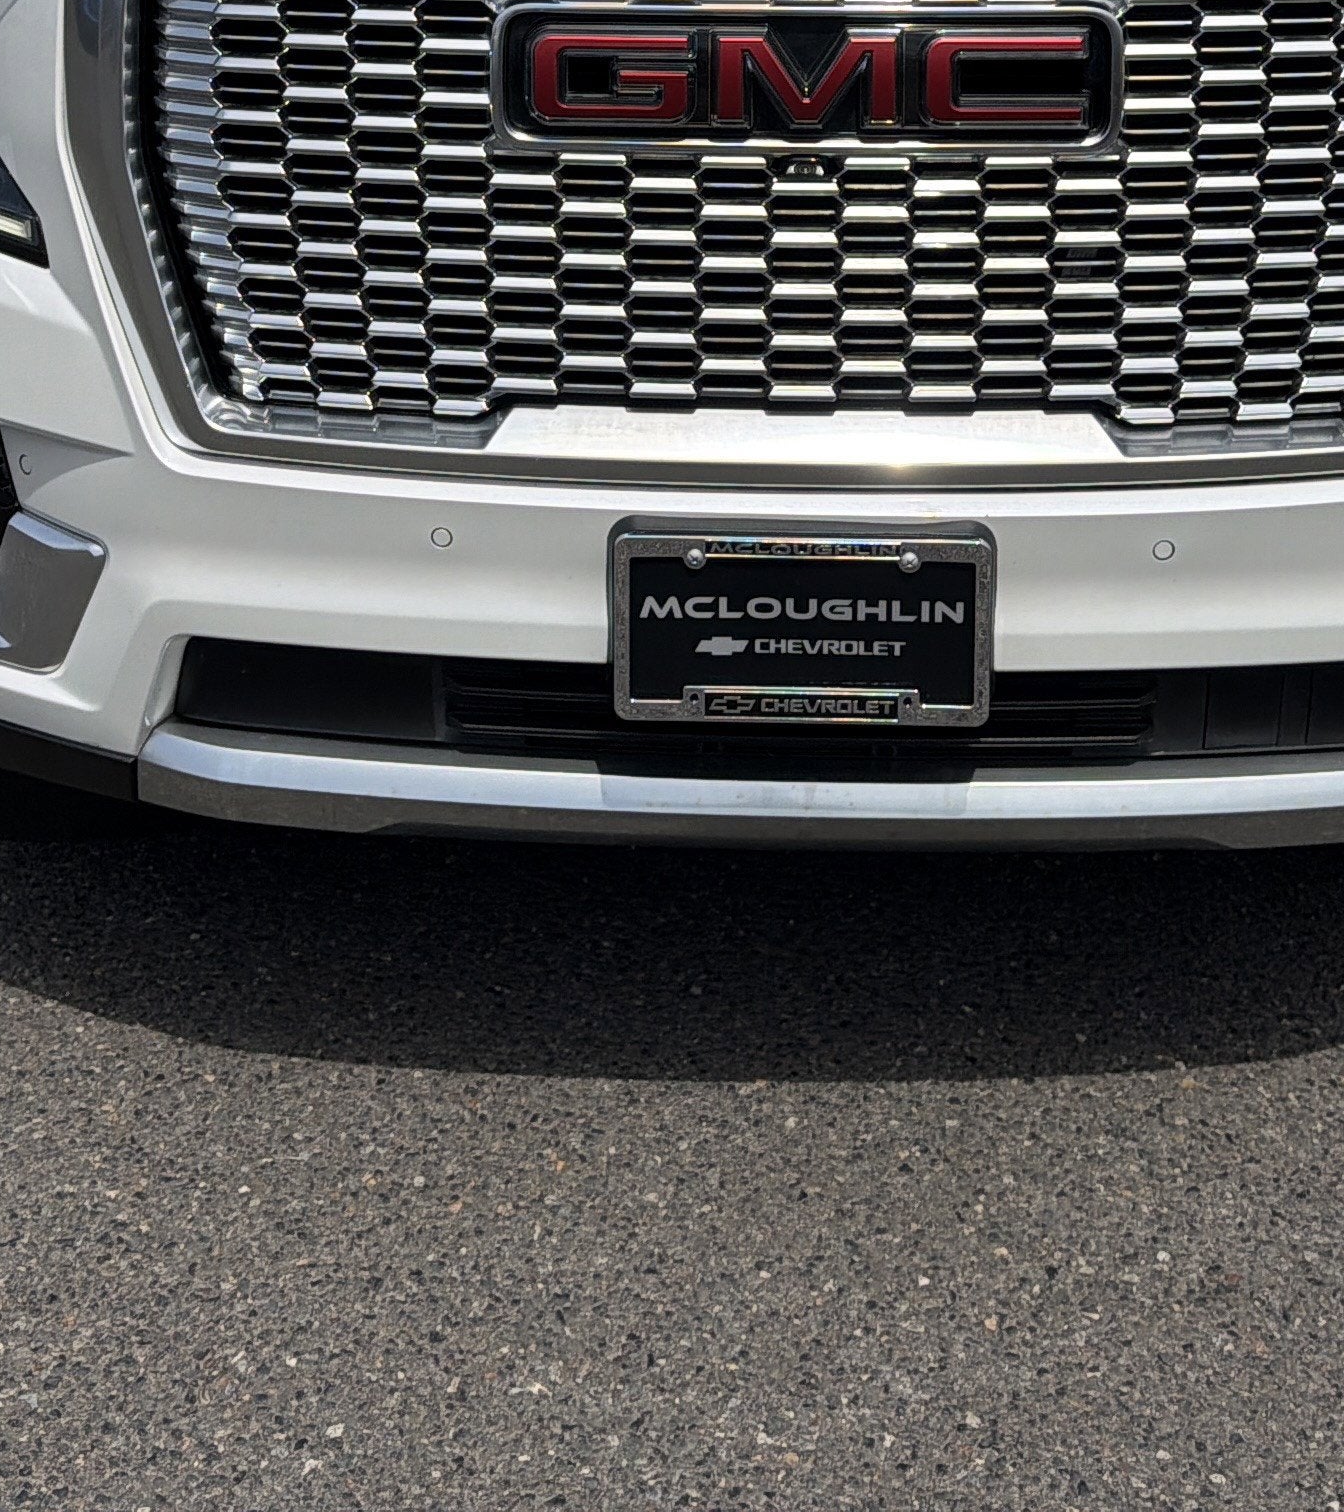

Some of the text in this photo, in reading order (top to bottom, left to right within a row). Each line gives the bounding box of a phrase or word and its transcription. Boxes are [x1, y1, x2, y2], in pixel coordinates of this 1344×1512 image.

[528, 26, 1090, 128] GMC
[710, 543, 896, 556] MCLOUGHLIN
[639, 595, 965, 624] MCLOUGHLIN
[754, 637, 907, 657] CHEVROLET
[760, 697, 896, 716] CHEVROLET
